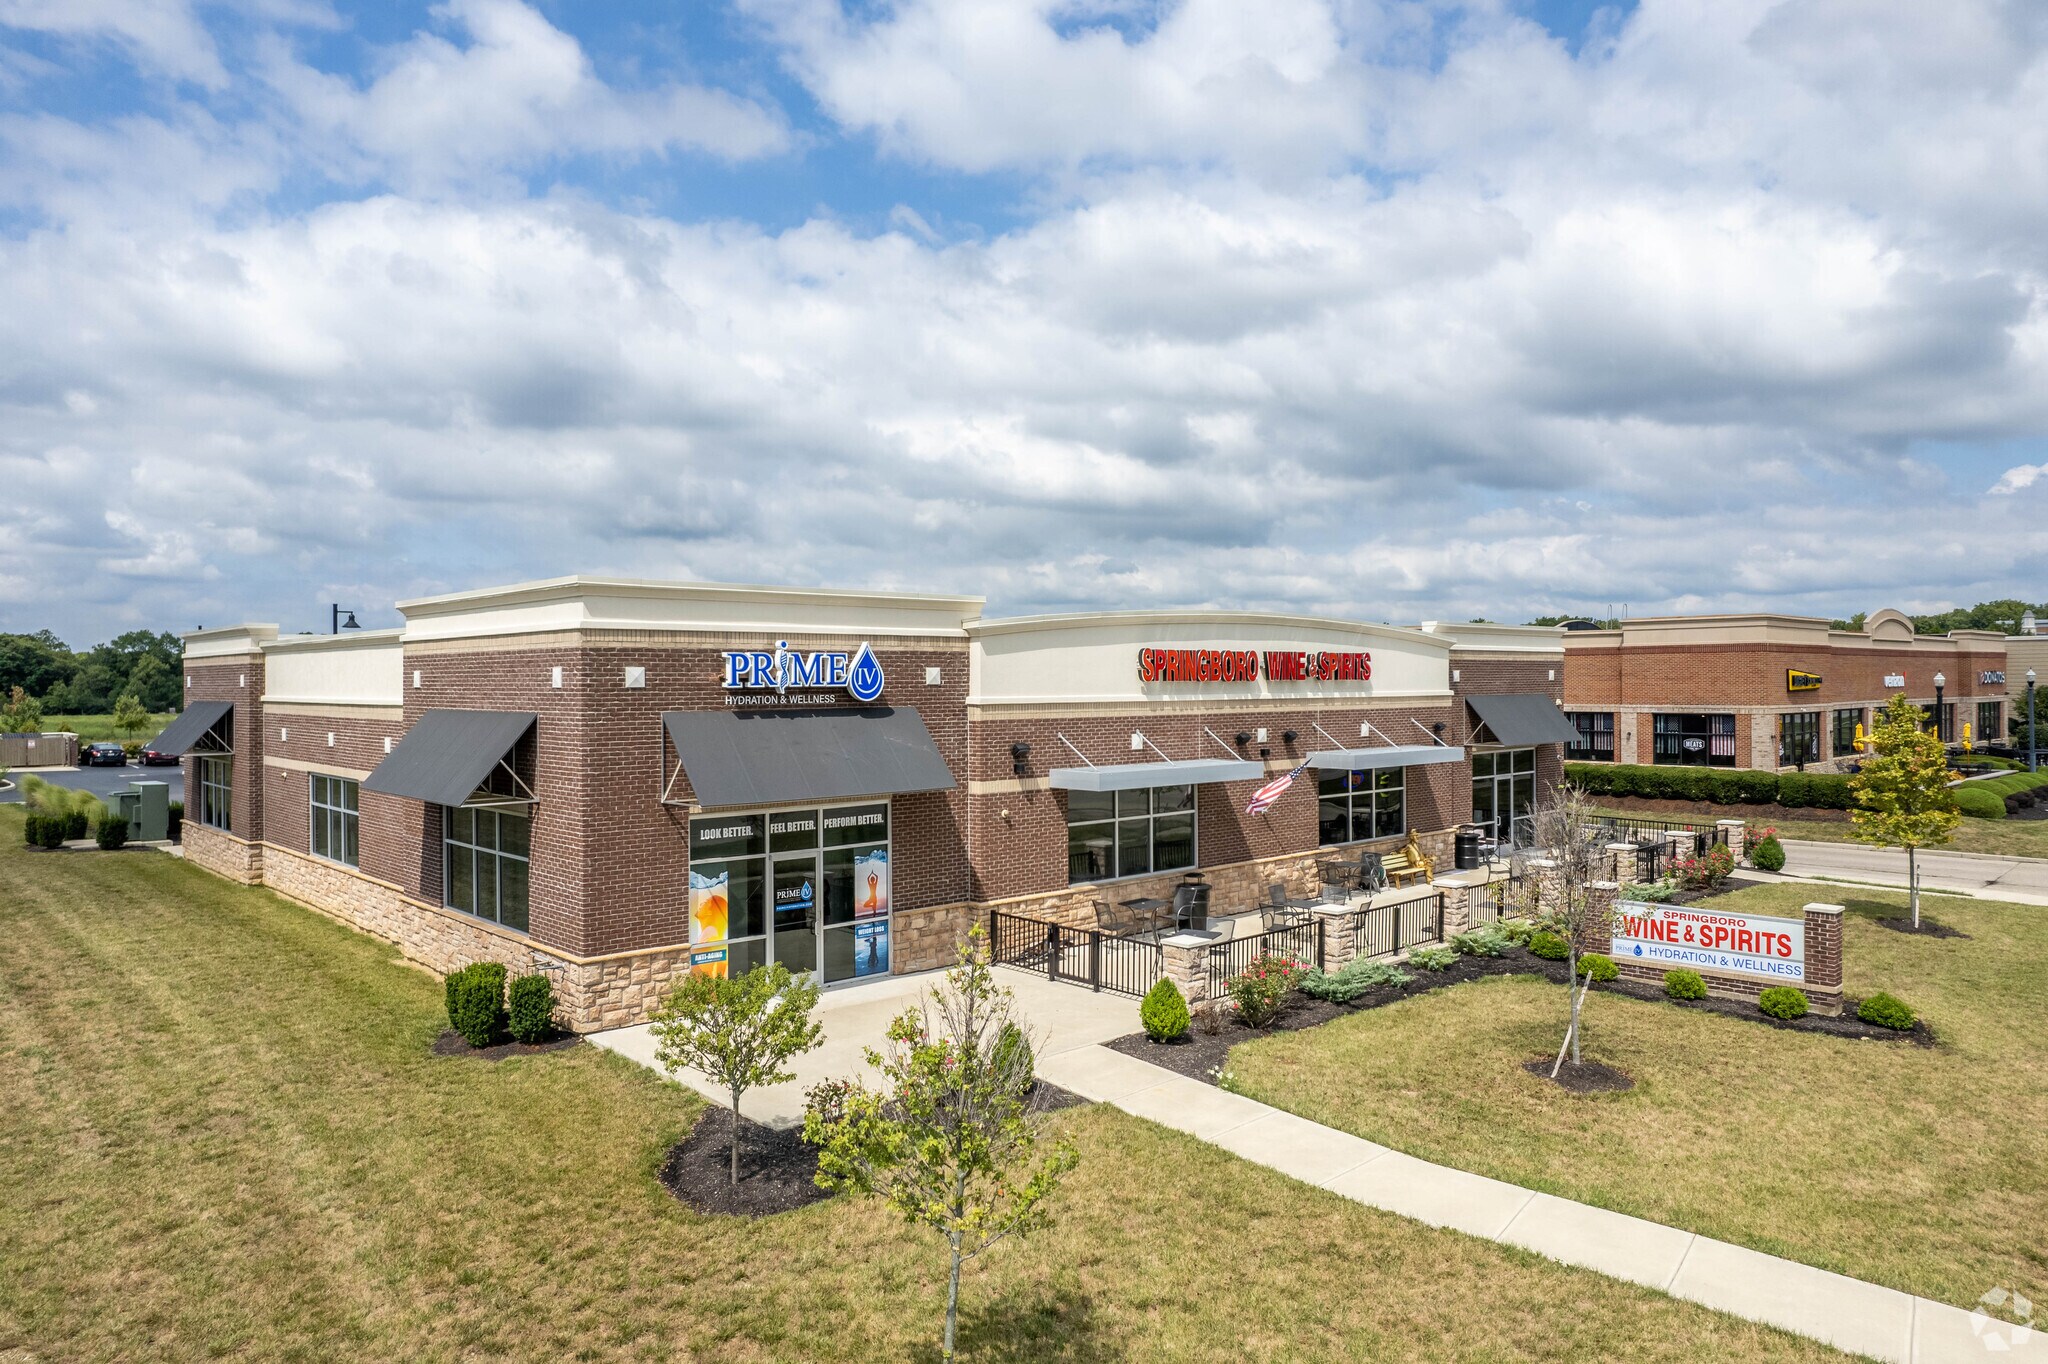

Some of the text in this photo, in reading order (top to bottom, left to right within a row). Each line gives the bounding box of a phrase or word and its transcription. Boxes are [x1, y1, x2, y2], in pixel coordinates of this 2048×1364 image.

[1138, 648, 1372, 682] SPRINGBORO WINE & SPIRITS
[857, 667, 876, 685] IV
[725, 694, 836, 705] HYDRATION & WELLNESS
[770, 820, 816, 834] FEEL BETTER.
[824, 813, 885, 829] PERFORM BETTER.
[700, 825, 754, 841] LOOK BETTER.
[1663, 911, 1746, 928] SPRINGBORO
[858, 927, 874, 936] WEIGHT
[1623, 915, 1792, 957] WINE & SPIRITS
[694, 951, 723, 961] ANTI-AGING
[1649, 947, 1802, 976] HYDRATION & WELLNESS
